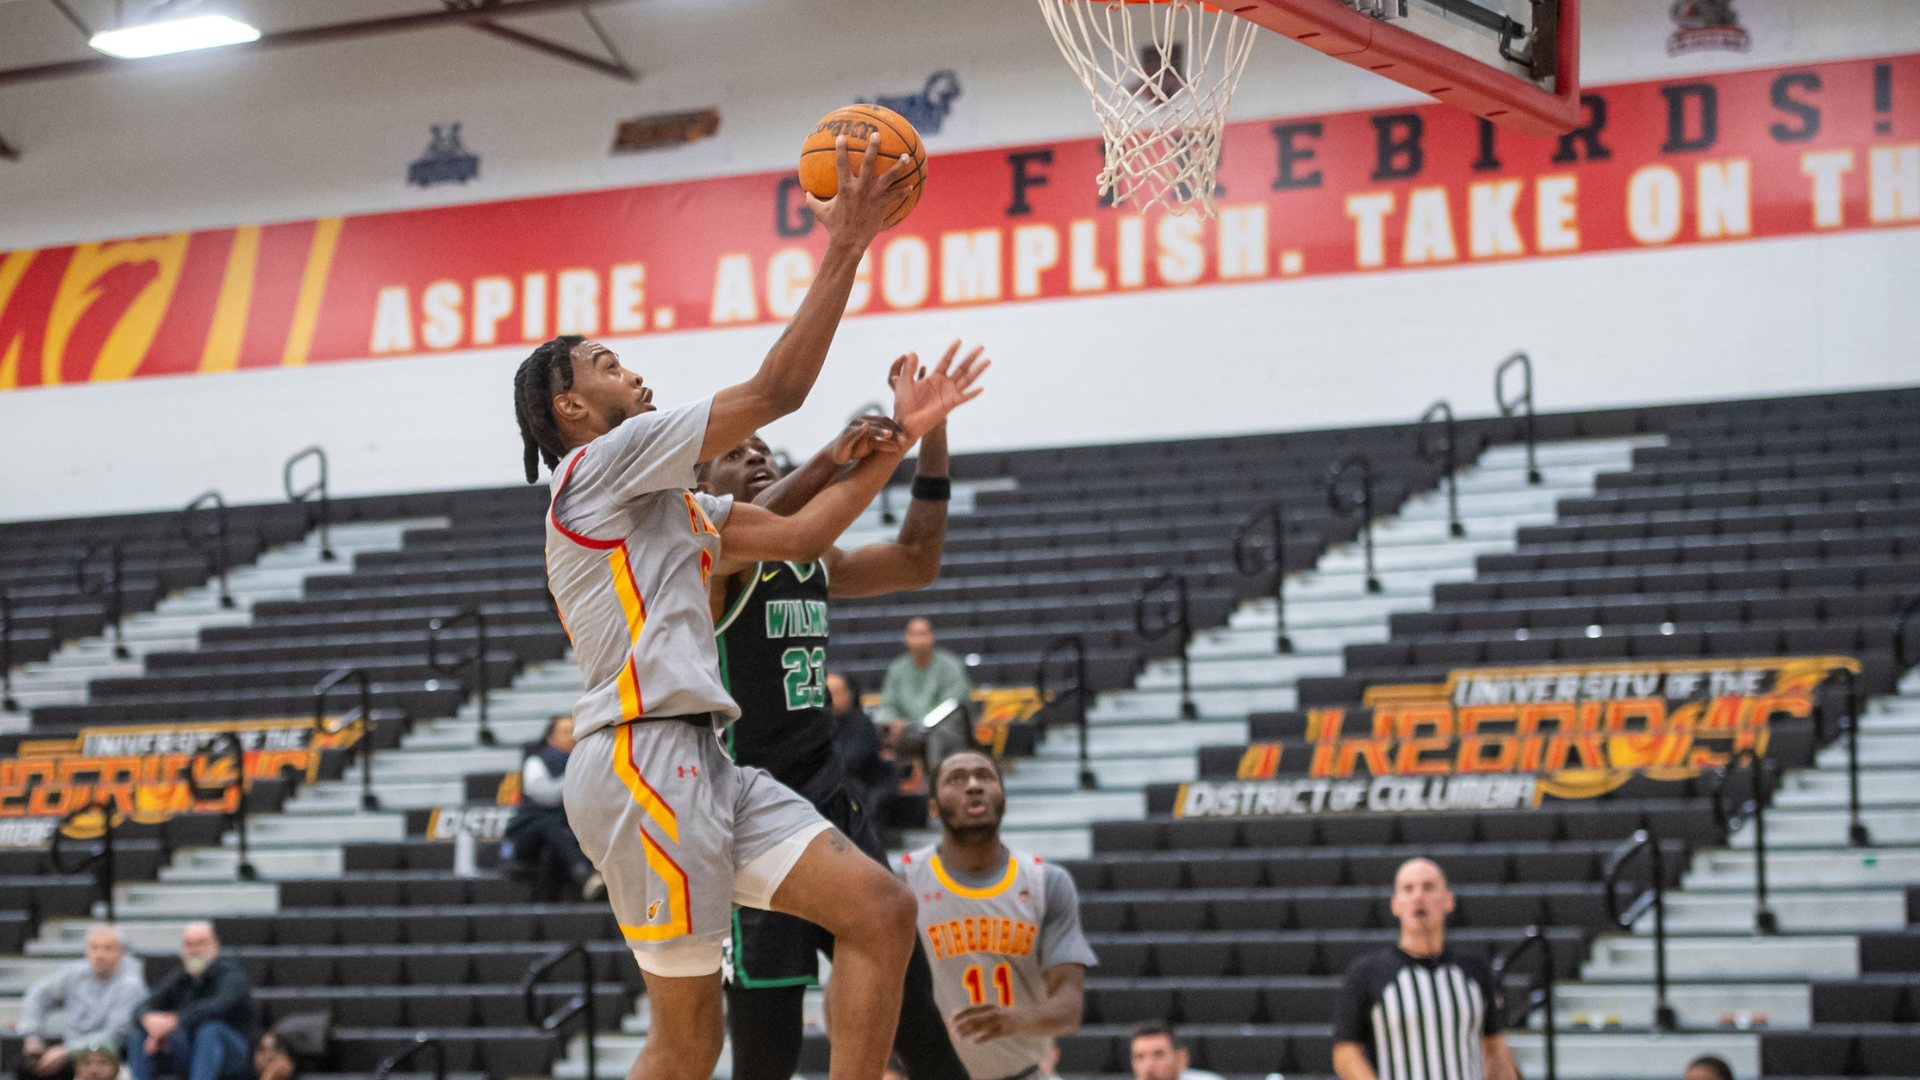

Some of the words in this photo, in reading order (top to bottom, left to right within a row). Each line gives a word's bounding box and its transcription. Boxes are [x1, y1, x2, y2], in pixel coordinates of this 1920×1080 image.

[369, 262, 675, 354] ASPIRE.
[710, 204, 1304, 326] ACCOMPLISH.
[1346, 174, 1580, 272] TAKE
[1626, 158, 1751, 246] ON
[927, 917, 1038, 960] FIREBIRDS
[962, 963, 1013, 1007] 11
